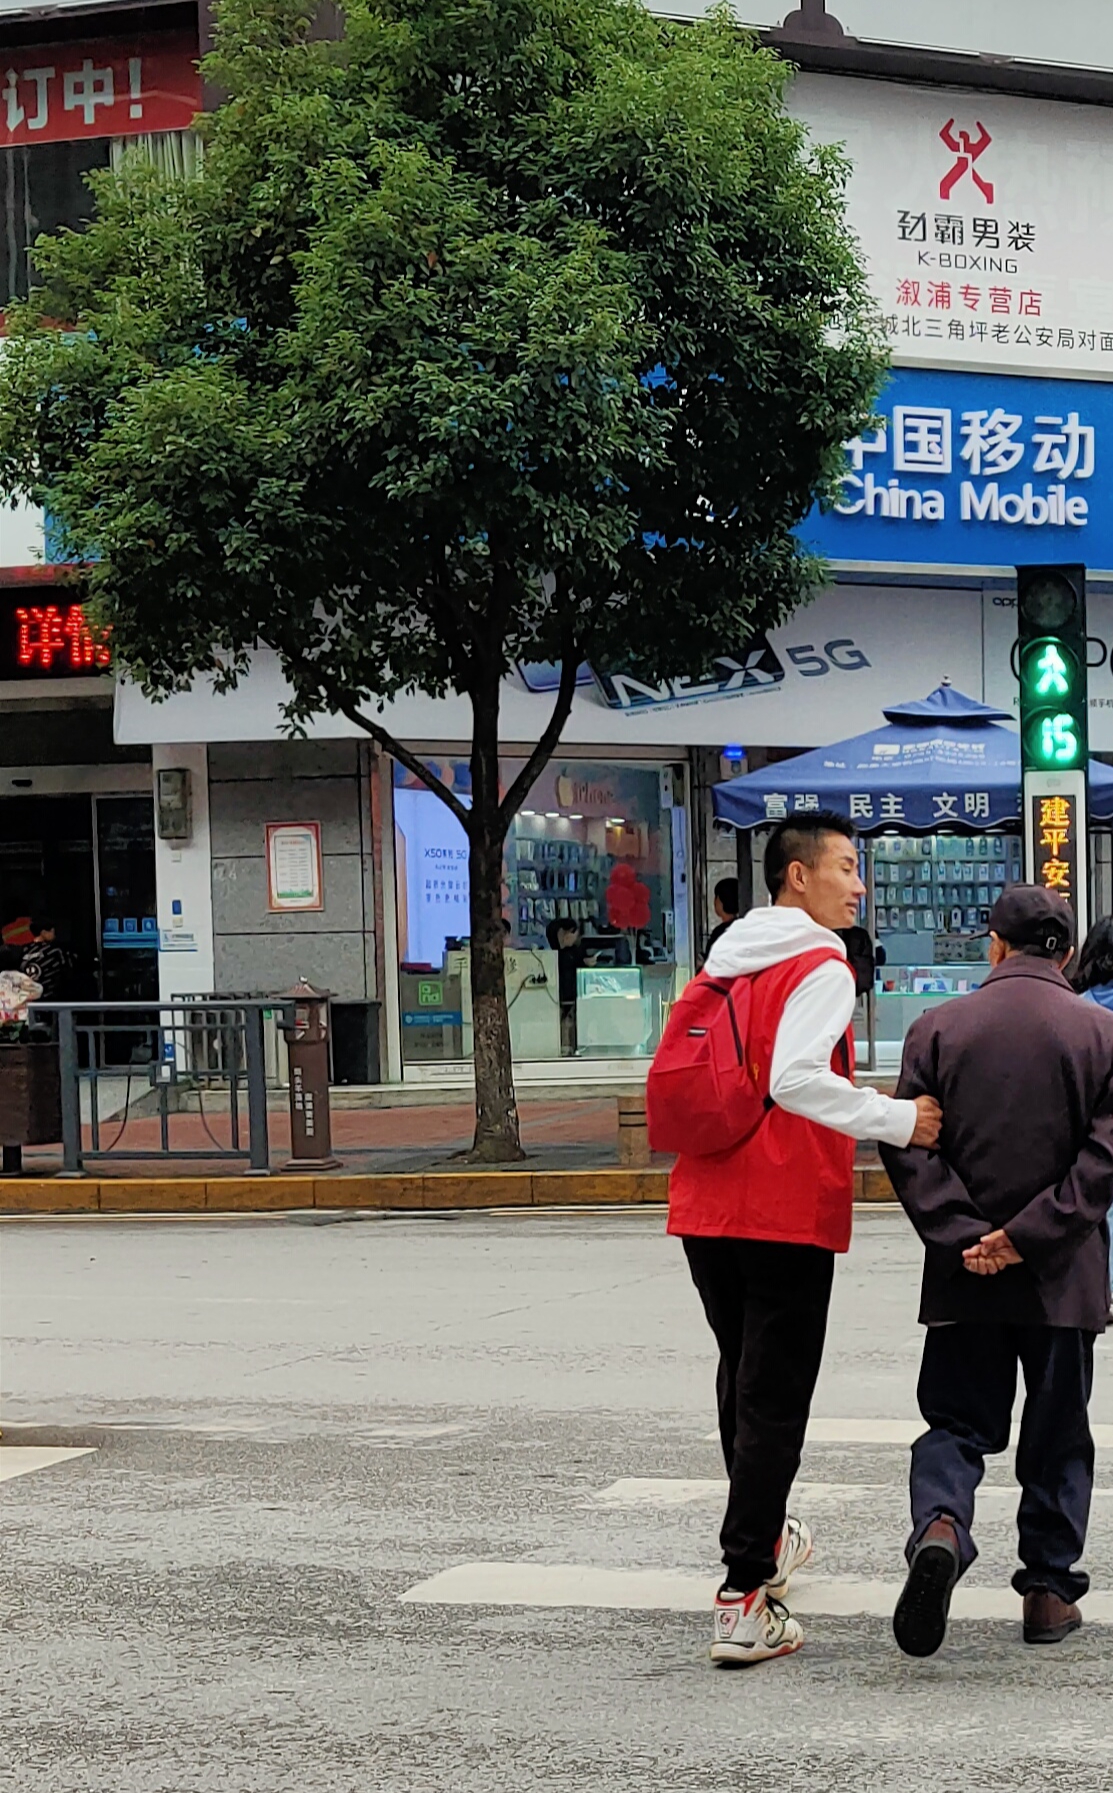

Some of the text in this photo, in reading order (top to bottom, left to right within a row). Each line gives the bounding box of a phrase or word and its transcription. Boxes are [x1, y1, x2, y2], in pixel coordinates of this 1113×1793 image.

[896, 209, 1037, 253] 劲霸男装
[917, 250, 1018, 275] K-BOXING
[896, 278, 1043, 317] 溆浦专营店
[833, 472, 1090, 527] China Mobile
[786, 638, 873, 677] 5G
[1041, 712, 1078, 762] 15
[850, 793, 905, 818] 民主
[933, 792, 990, 819] 文明
[1039, 796, 1070, 904] 建平安
